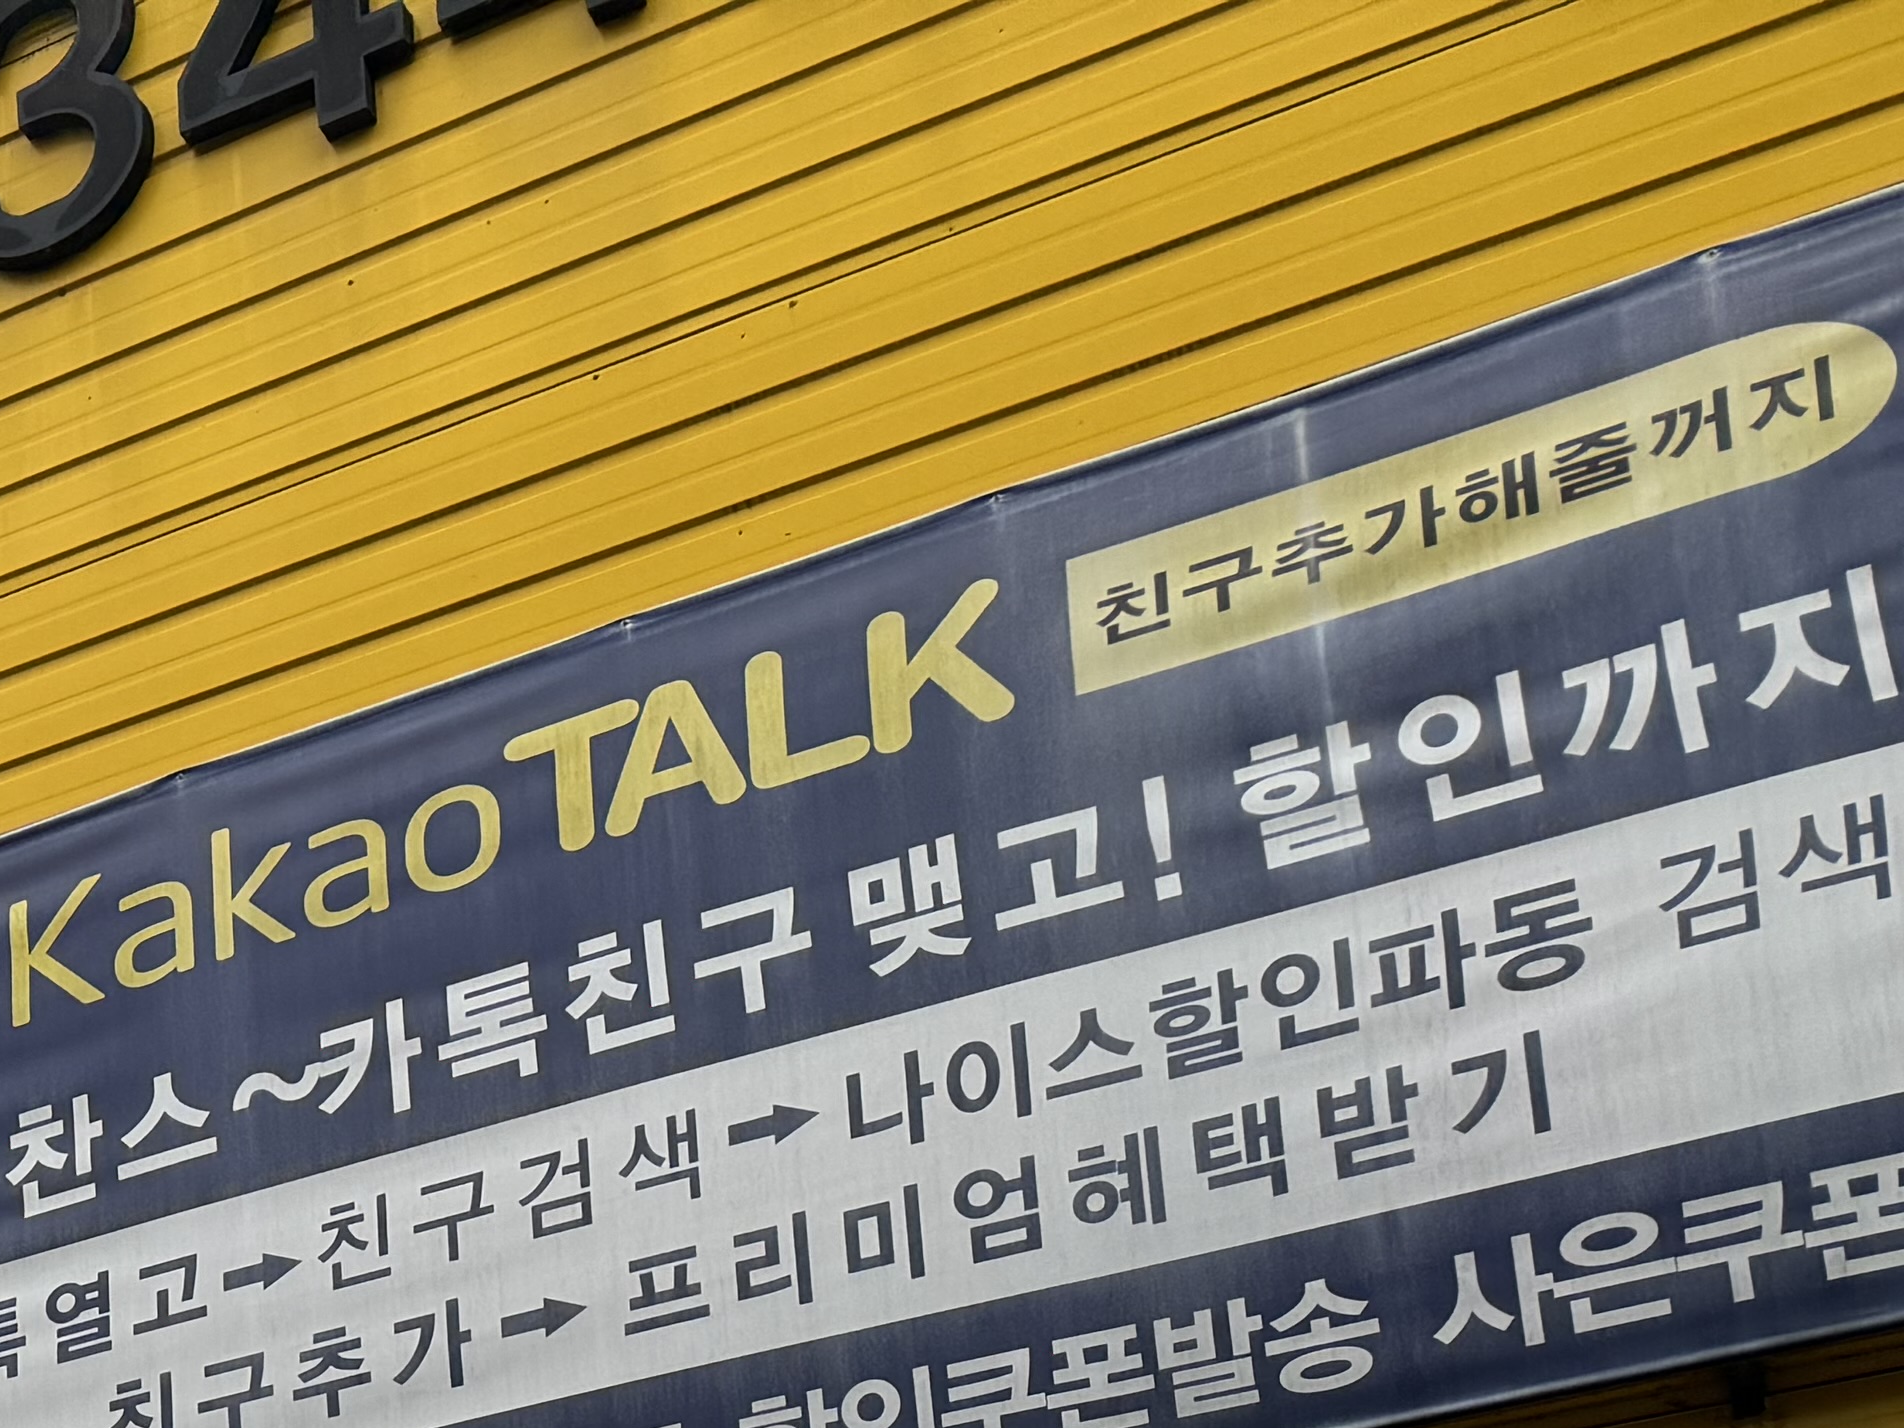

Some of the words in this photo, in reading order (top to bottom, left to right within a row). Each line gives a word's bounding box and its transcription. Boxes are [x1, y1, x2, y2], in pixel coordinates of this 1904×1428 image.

[1094, 355, 1837, 647] 친구추가해줄꺼지
[6, 576, 1016, 1030] KakaoTALK
[847, 778, 1182, 979] 맺고!
[1233, 564, 1904, 869] 할인까지
[317, 1107, 705, 1293] 친구검색
[844, 879, 1593, 1146] 나이스할인파동
[1658, 792, 1893, 950] 검색
[622, 1029, 1553, 1338] 프리미엄혜택받기
